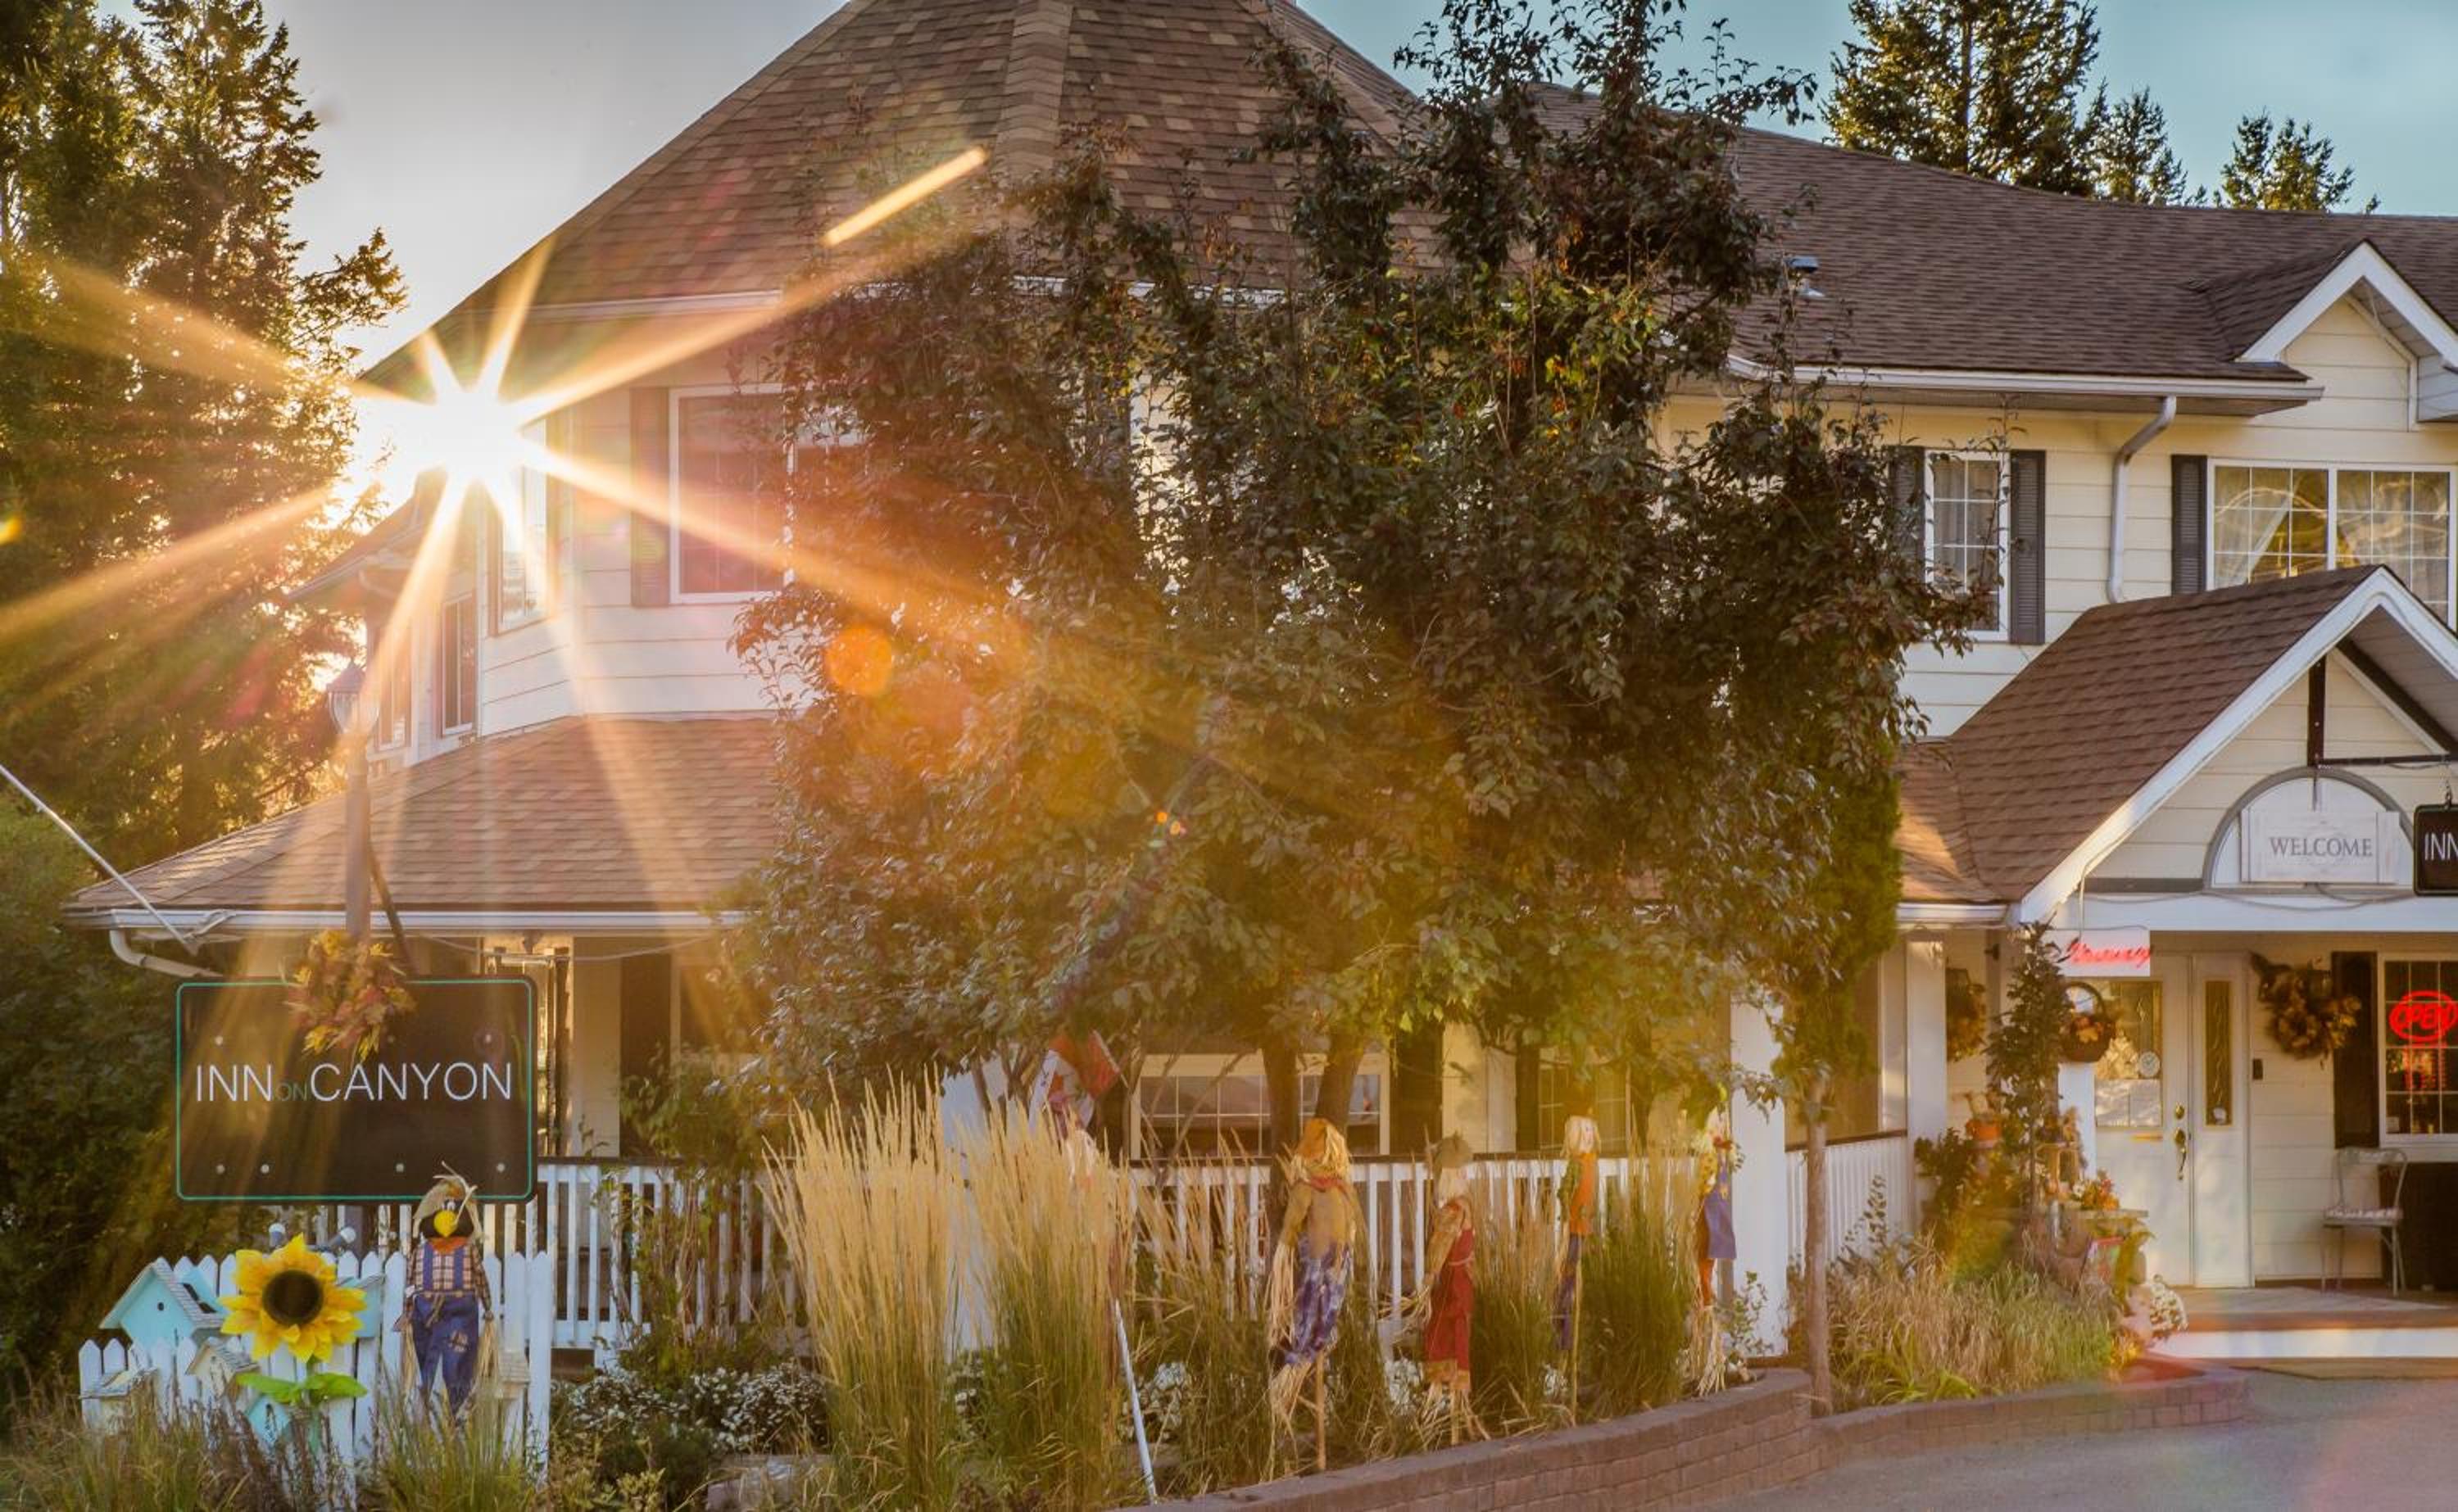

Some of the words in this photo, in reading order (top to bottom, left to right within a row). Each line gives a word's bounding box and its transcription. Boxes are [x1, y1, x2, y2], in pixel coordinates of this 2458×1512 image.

[2268, 836, 2373, 858] WELCOME
[2393, 1001, 2451, 1031] OPEN
[197, 1064, 273, 1102] INN
[275, 1081, 307, 1102] ON
[311, 1062, 512, 1102] CANYON
